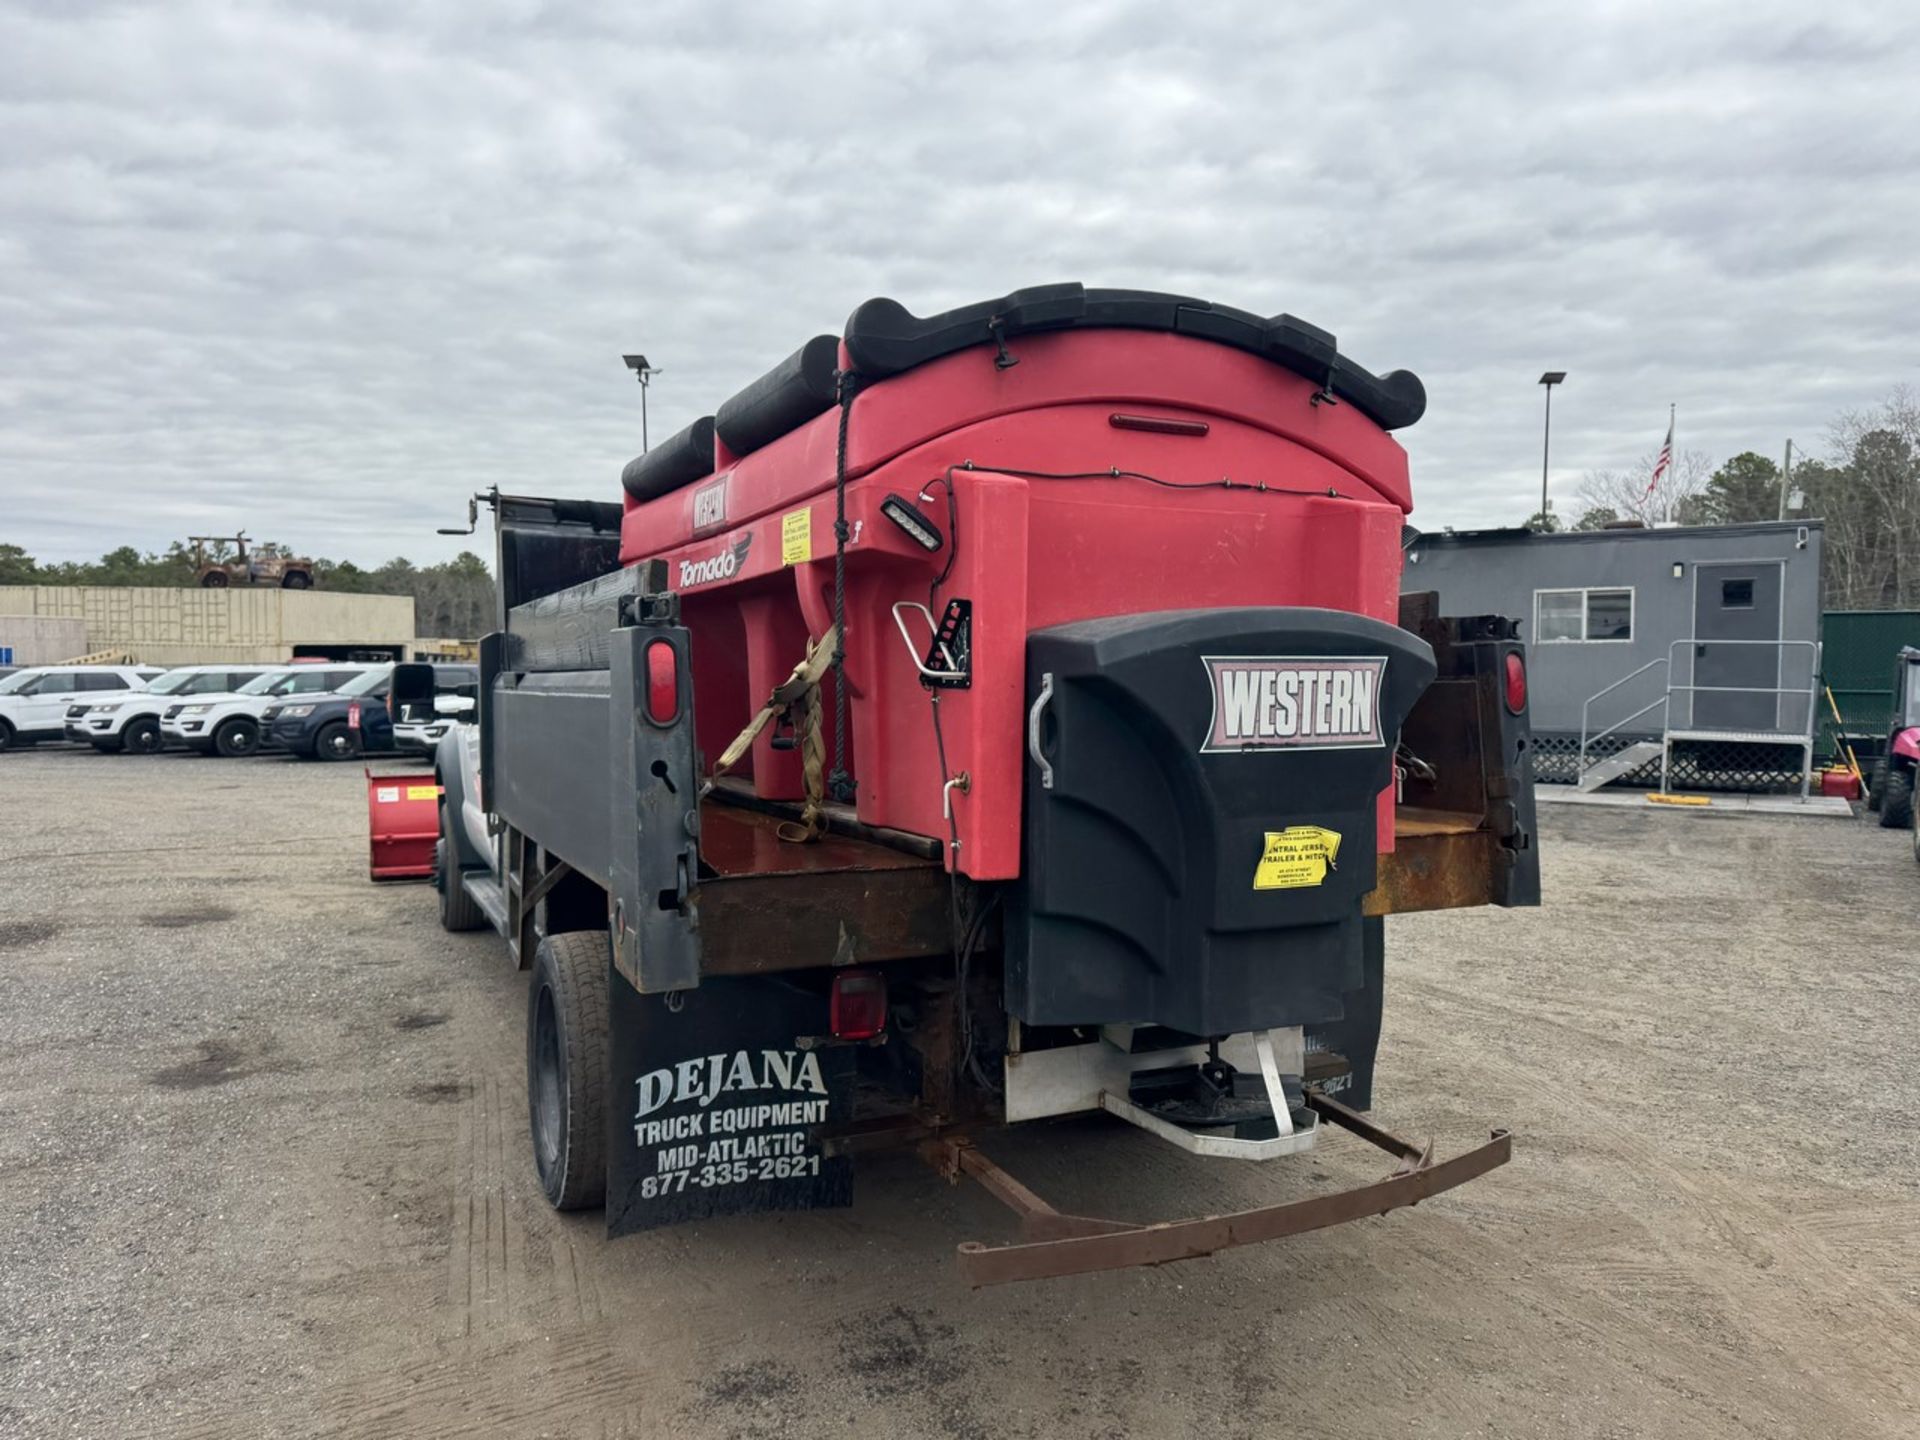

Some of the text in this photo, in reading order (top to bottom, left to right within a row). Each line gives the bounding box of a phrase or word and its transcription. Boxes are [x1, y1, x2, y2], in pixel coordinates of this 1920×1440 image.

[679, 549, 736, 588] Tornado
[1221, 669, 1373, 738] WESTERN
[1263, 853, 1295, 863] TRAILER
[634, 1049, 829, 1120] DEJANA
[633, 1099, 830, 1148] TRUCK EQUIPMENT
[657, 1131, 806, 1173] MID-ATLANTIC
[640, 1154, 821, 1200] 877-335-2621
